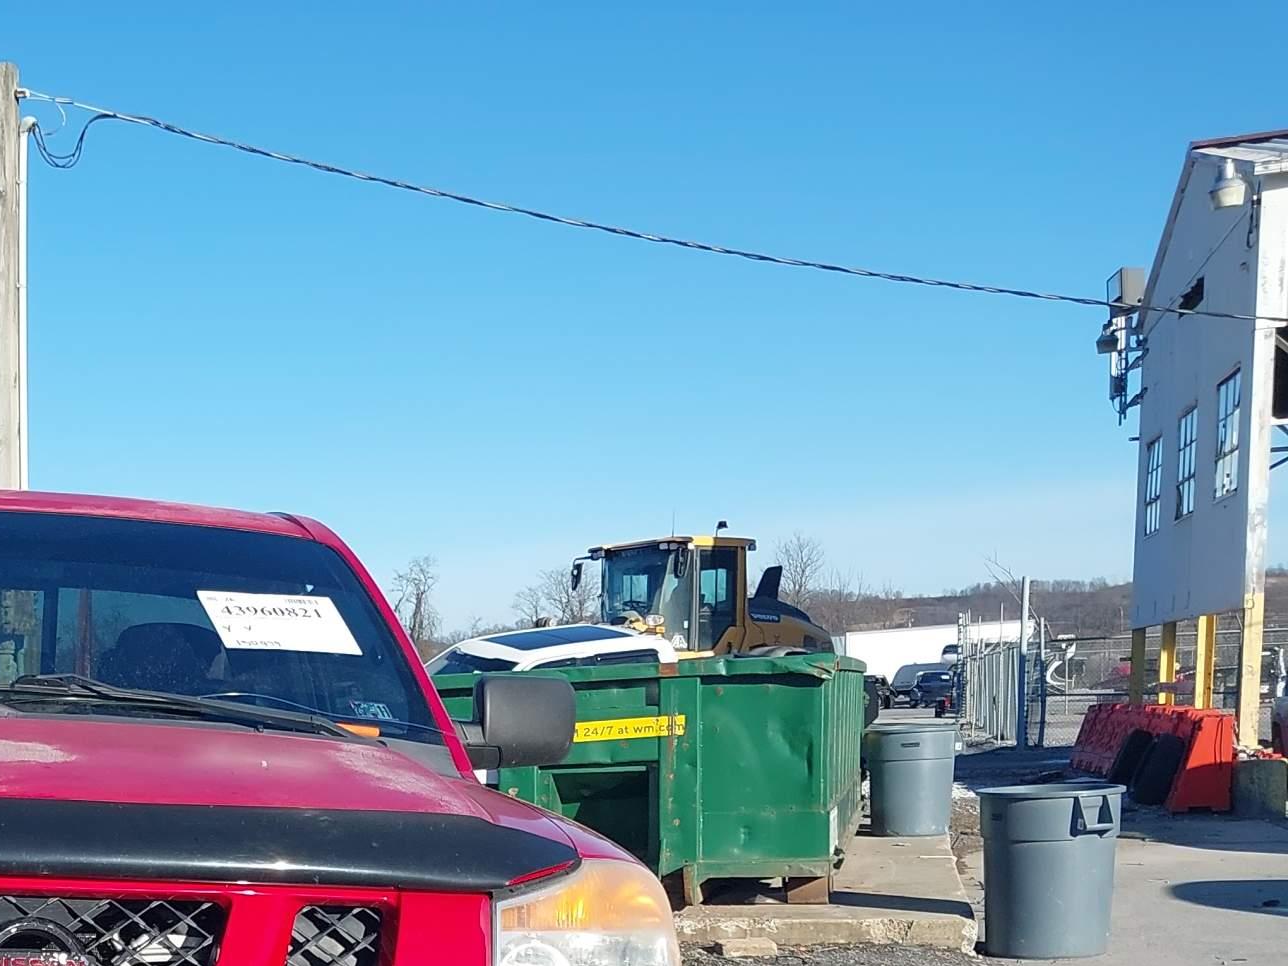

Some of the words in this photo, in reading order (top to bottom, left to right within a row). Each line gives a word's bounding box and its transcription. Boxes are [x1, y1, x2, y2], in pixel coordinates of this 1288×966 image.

[221, 605, 322, 618] 43960821
[583, 726, 614, 737] 24/7
[617, 725, 629, 735] at
